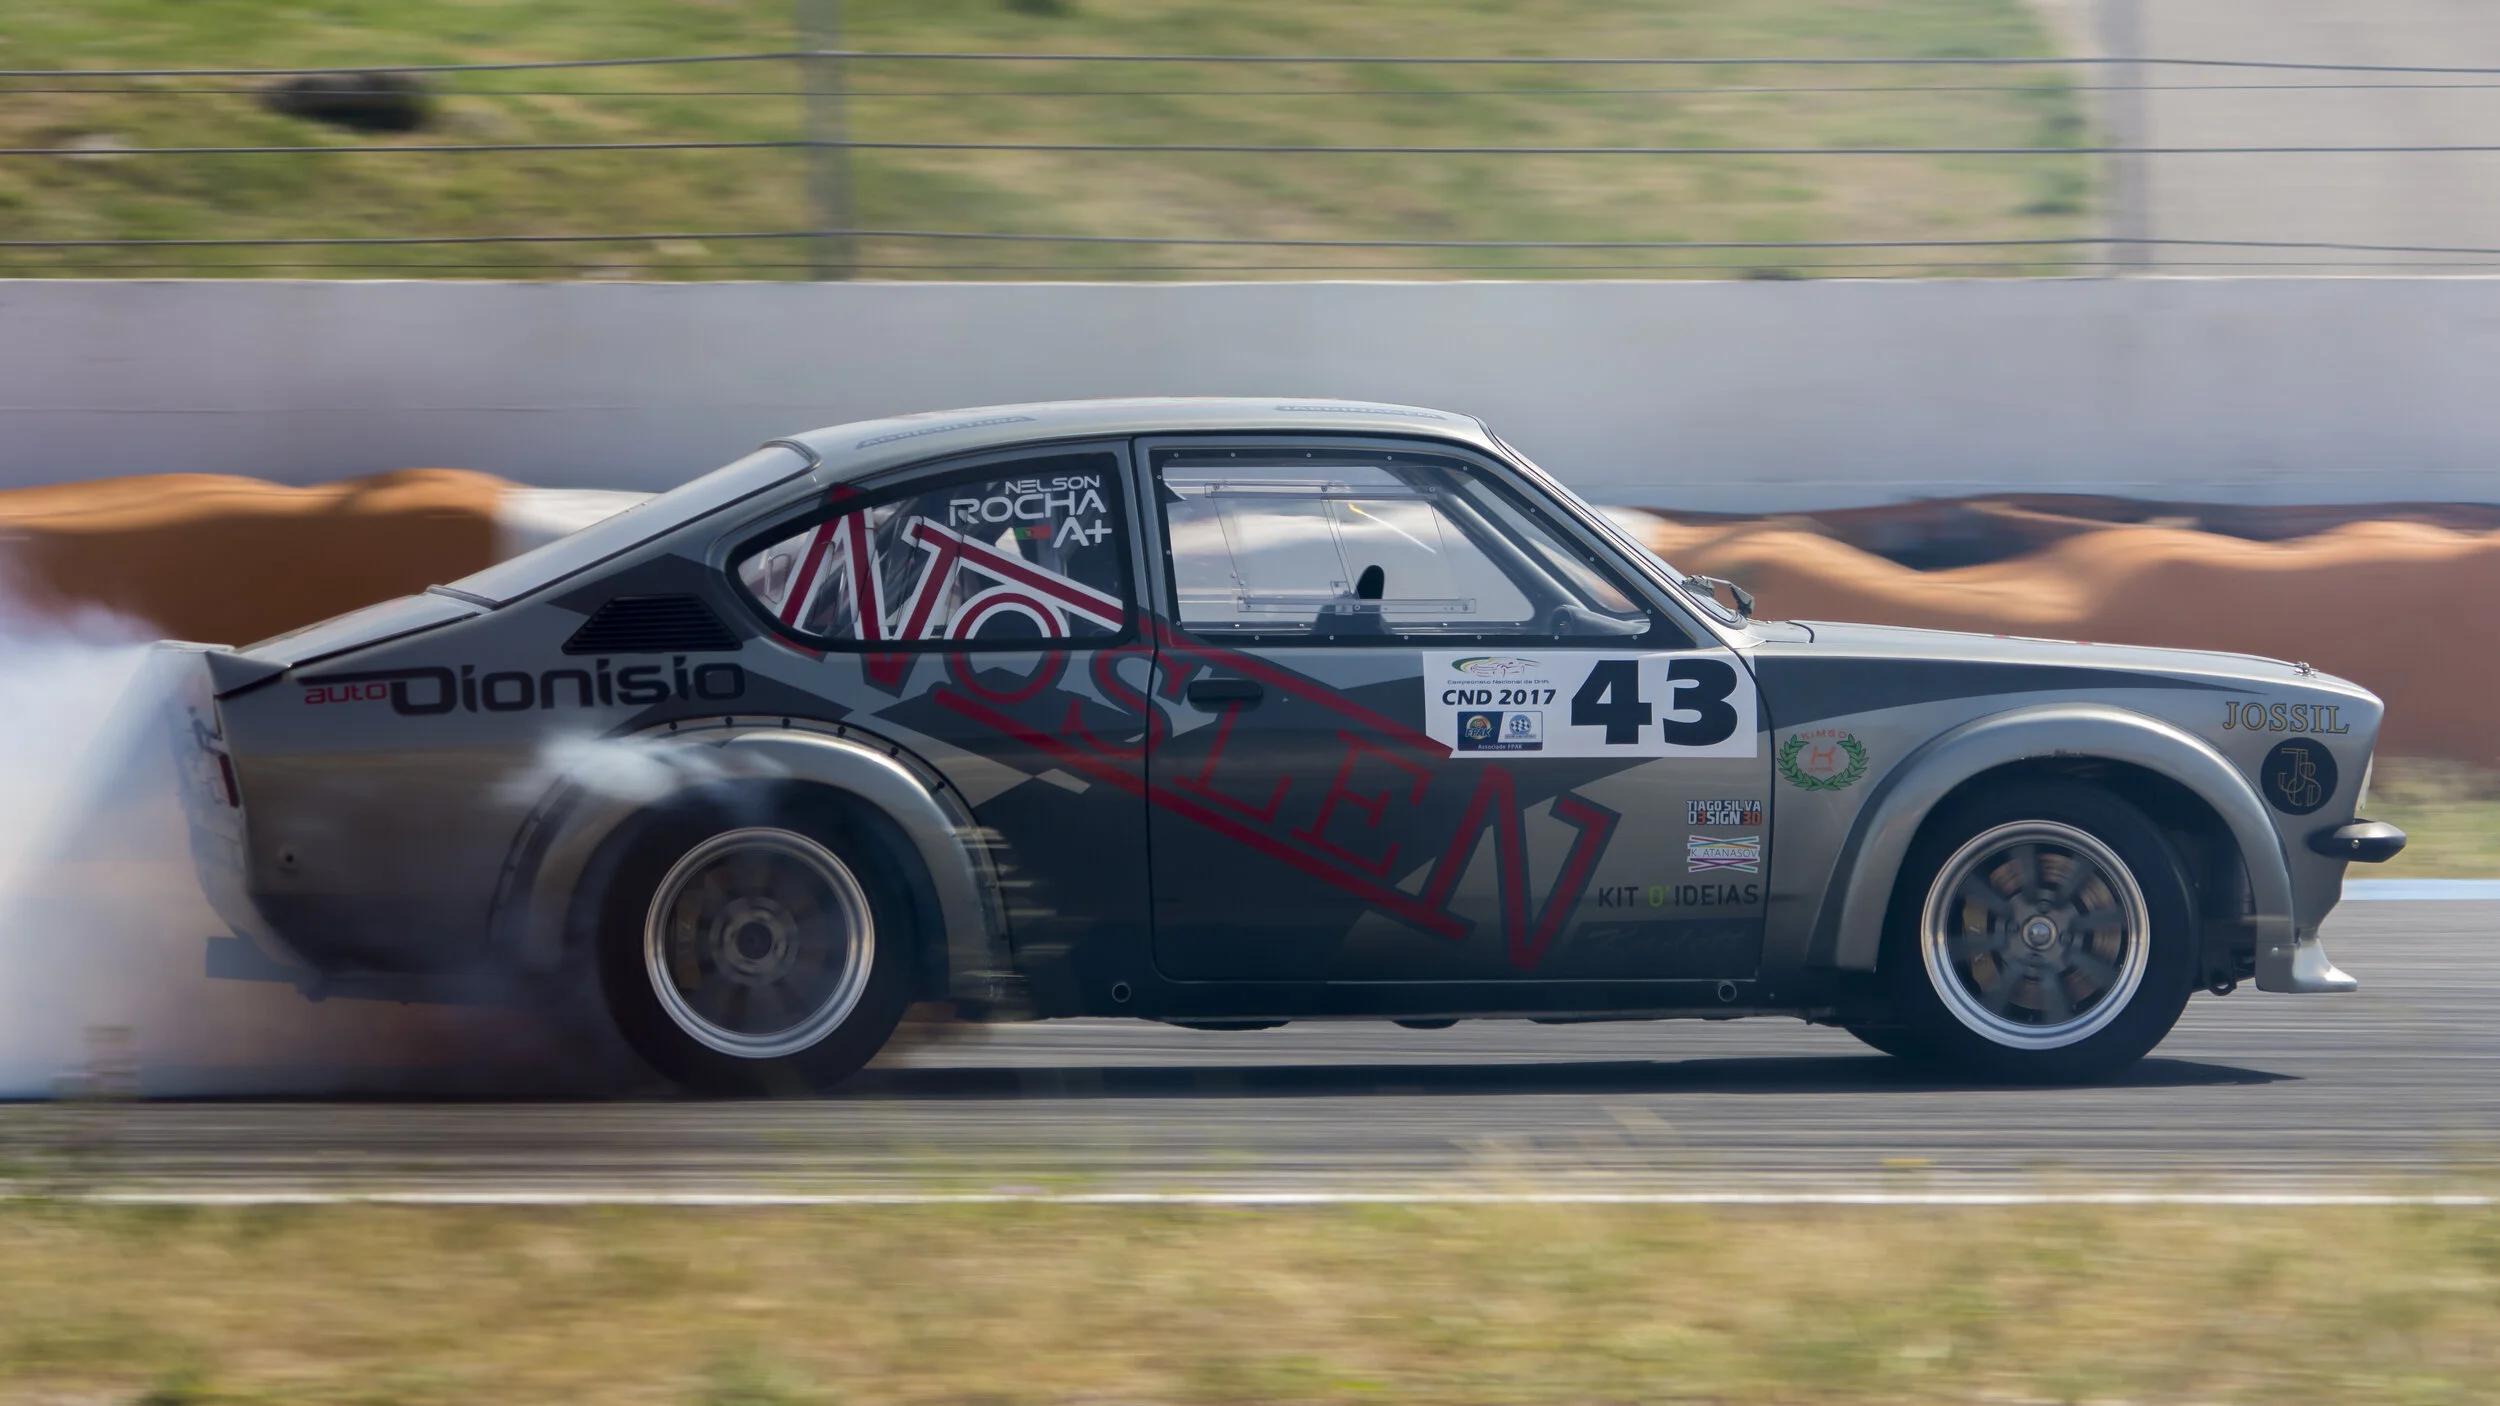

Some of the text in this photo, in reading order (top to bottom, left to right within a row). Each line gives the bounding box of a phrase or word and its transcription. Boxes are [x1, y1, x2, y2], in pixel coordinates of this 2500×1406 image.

[1005, 475, 1100, 494] NELSON
[949, 489, 1106, 526] ROCHA
[1053, 517, 1112, 548] A+
[305, 683, 388, 705] auto
[1442, 689, 1556, 705] CND 2017
[1571, 659, 1738, 746] 43
[2222, 701, 2350, 734] JOSSIL
[1465, 728, 1492, 738] FPAK
[1687, 800, 1722, 811] TIAGO
[1702, 849, 1757, 858] ATANASOV
[1598, 886, 1639, 907] KIT
